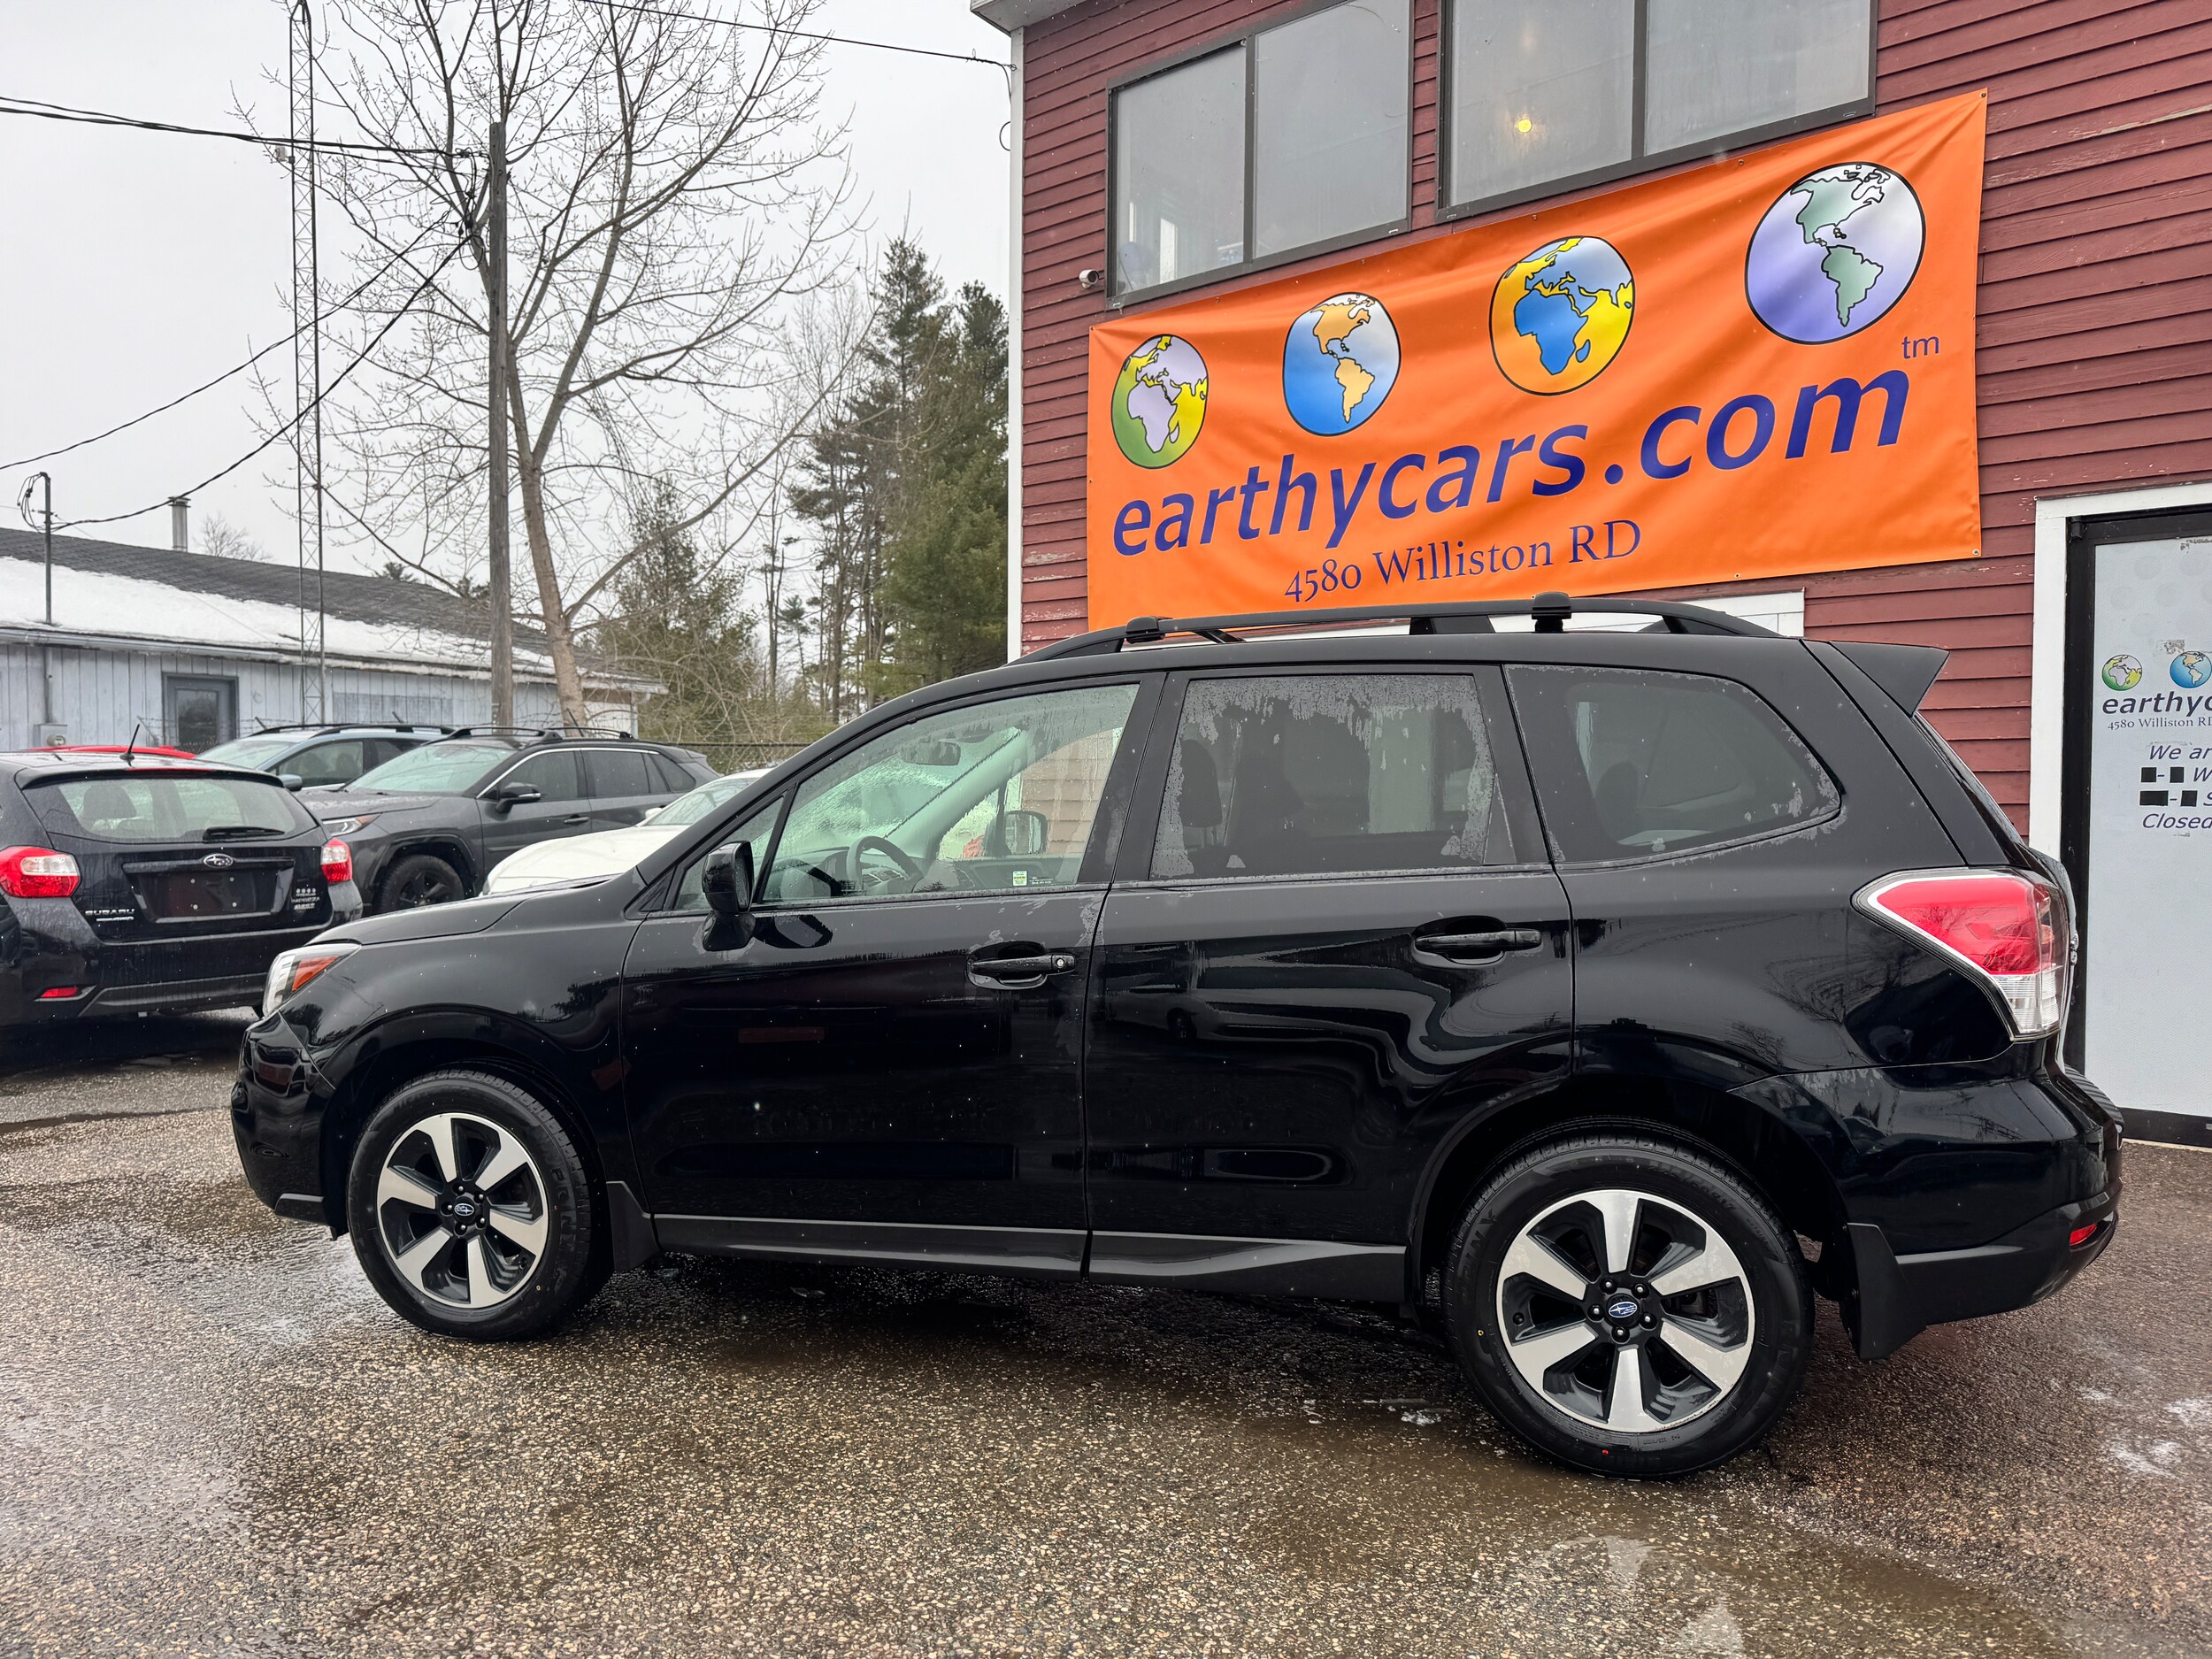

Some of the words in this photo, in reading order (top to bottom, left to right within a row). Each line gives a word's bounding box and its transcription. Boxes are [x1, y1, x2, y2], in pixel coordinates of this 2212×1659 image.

[1113, 369, 1909, 556] earthycars.com
[1901, 334, 1939, 359] tm
[1285, 558, 1362, 603] 4580
[1372, 540, 1553, 586] Williston
[1569, 519, 1641, 563] RD
[2108, 719, 2134, 731] 4580
[2139, 717, 2193, 727] Williston
[2149, 745, 2182, 759] We
